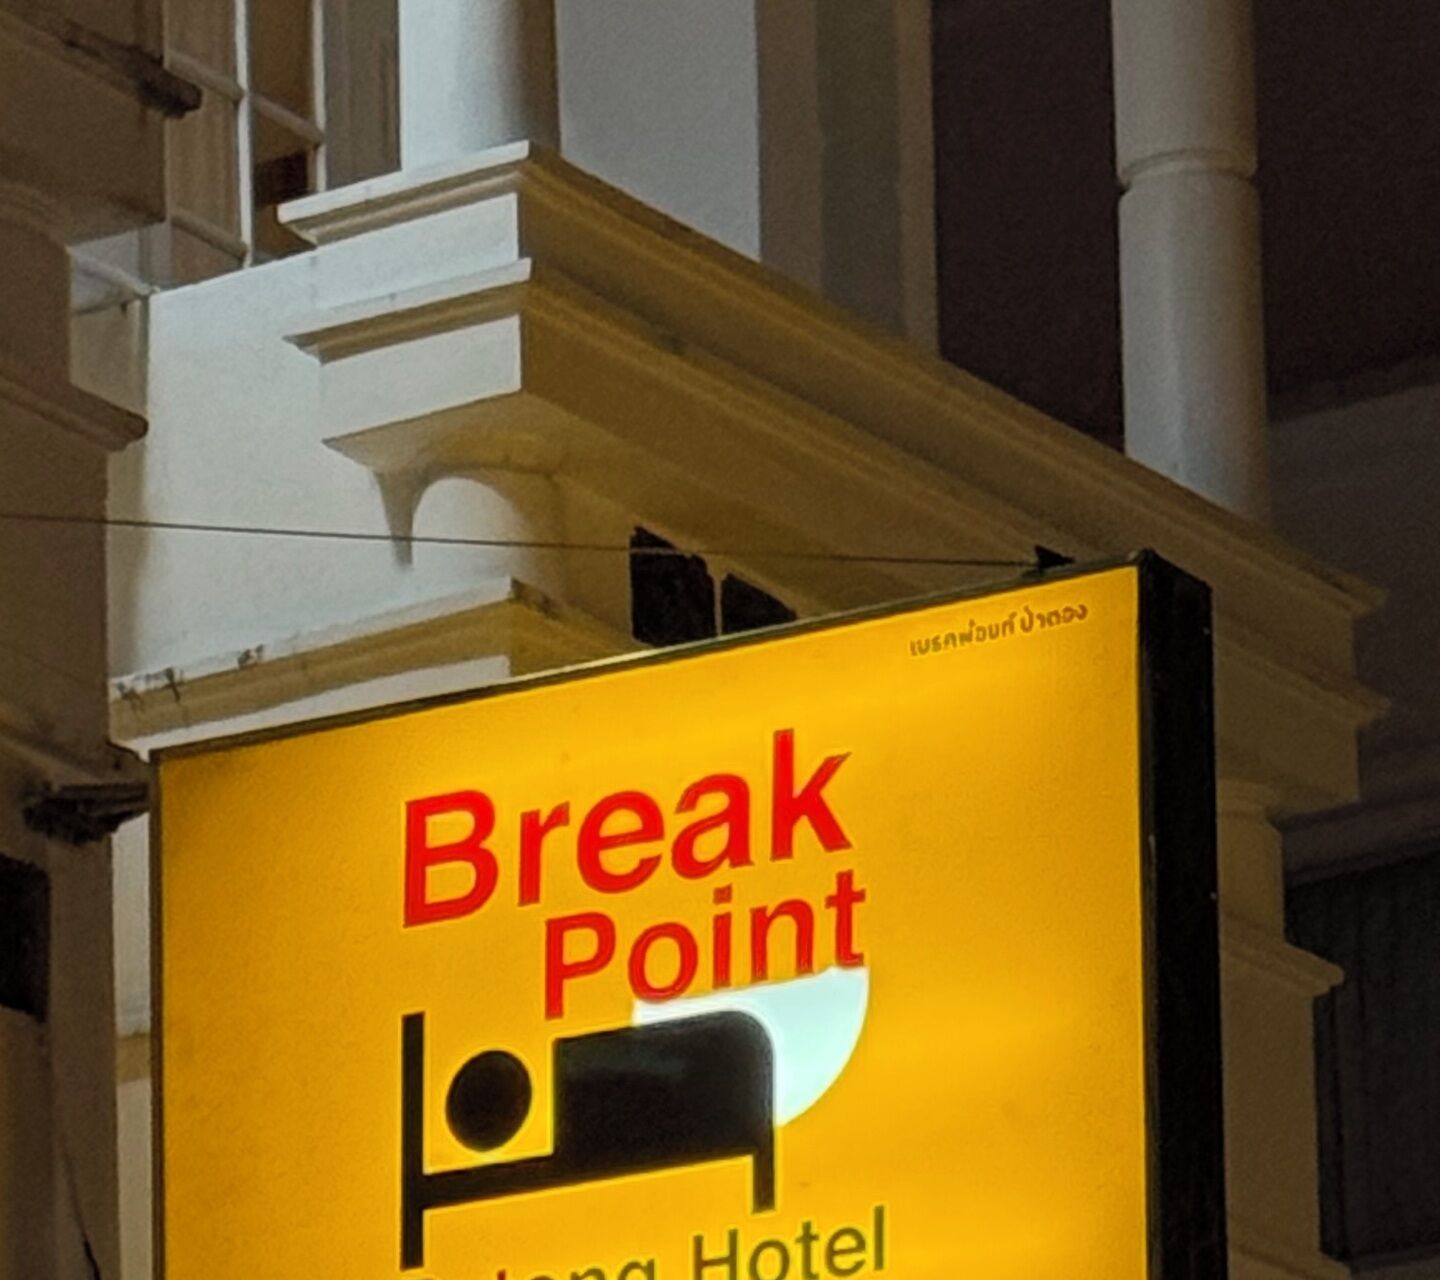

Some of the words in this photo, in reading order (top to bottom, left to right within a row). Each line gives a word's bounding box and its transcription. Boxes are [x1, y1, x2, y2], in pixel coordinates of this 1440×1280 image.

[1019, 604, 1089, 633] ป่าตอง
[403, 728, 853, 928] Break
[545, 870, 866, 1020] Point
